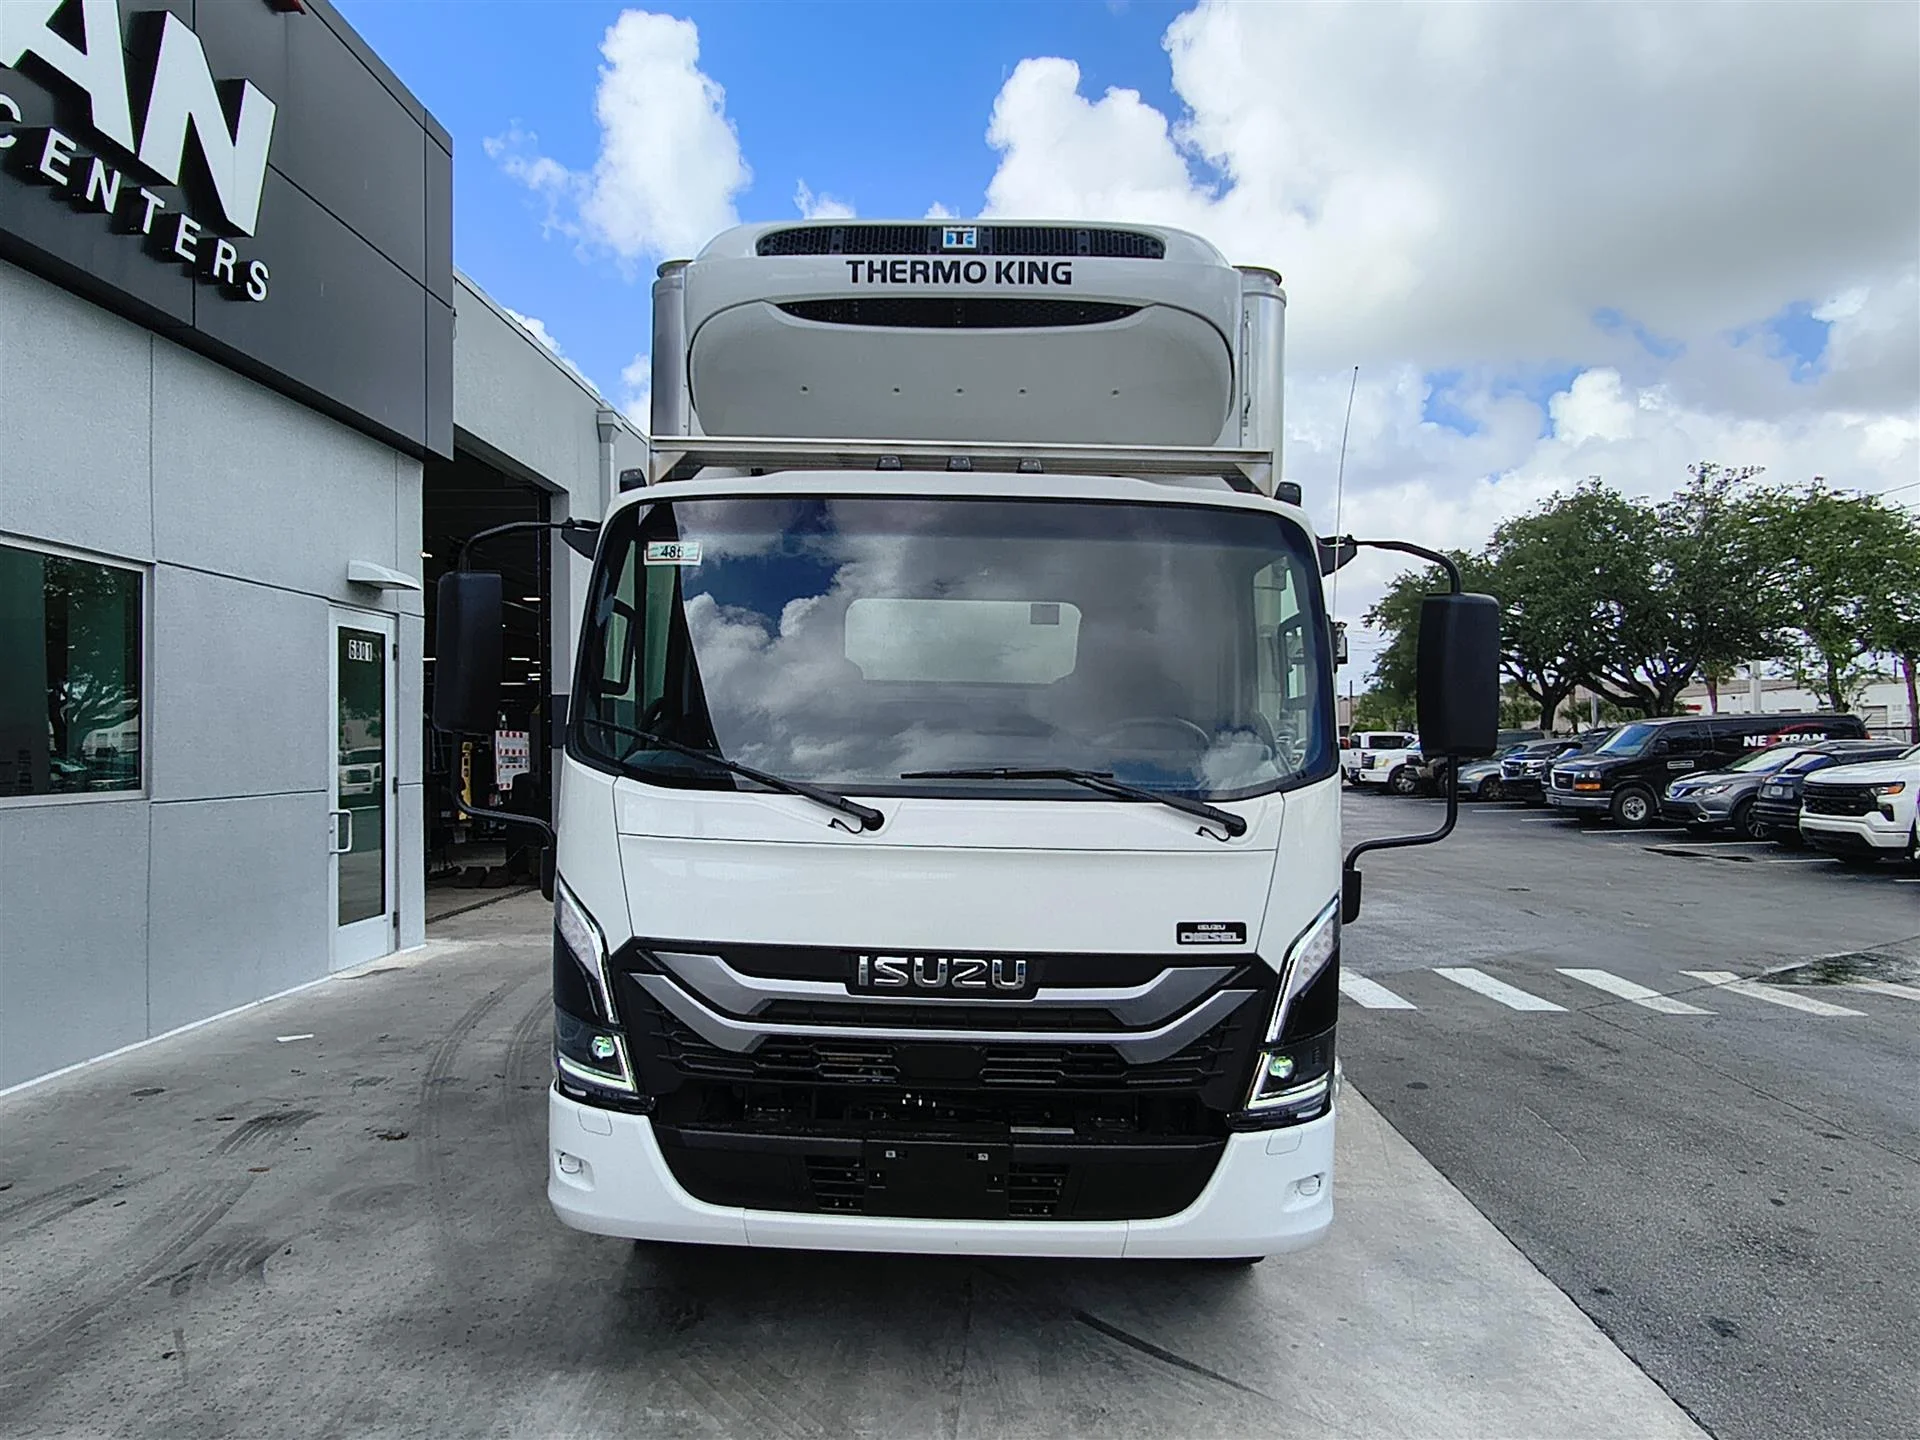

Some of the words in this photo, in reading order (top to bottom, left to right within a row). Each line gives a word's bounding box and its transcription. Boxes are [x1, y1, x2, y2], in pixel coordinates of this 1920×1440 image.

[846, 260, 987, 285] THERMO
[995, 261, 1072, 286] KING
[1181, 932, 1243, 942] DIESEL
[858, 955, 1026, 990] ISUZU
